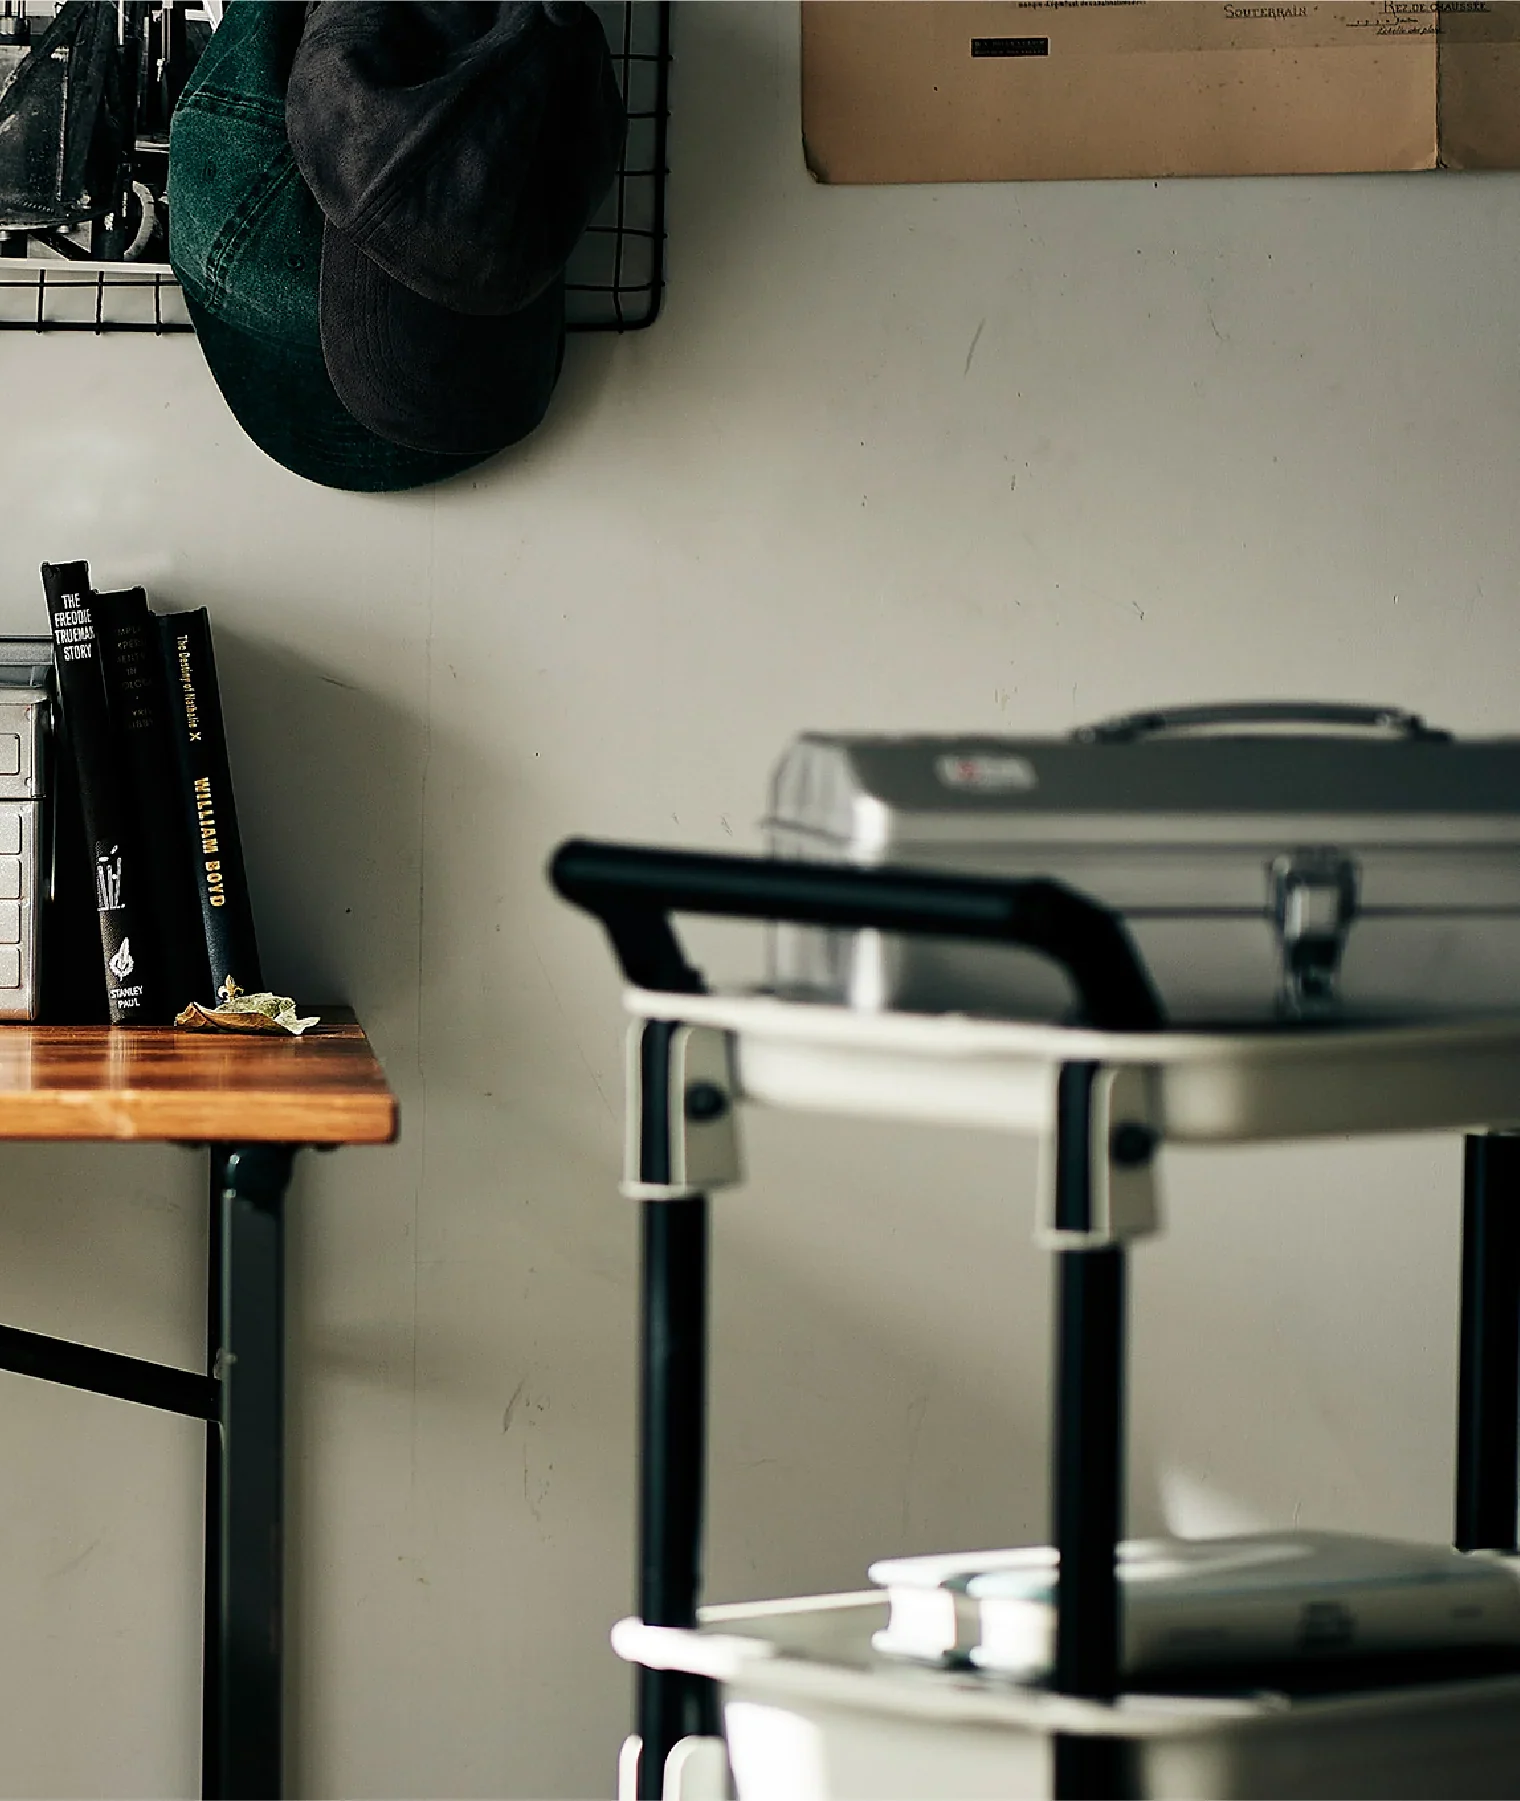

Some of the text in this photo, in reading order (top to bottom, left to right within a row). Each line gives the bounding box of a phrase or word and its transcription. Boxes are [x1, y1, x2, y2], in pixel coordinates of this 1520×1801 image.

[61, 593, 80, 609] THE
[54, 608, 92, 628] FREDDIE
[63, 643, 92, 661] STORY
[177, 635, 189, 651] The
[189, 731, 202, 742] X
[193, 776, 227, 907] WILLIAM BOYD
[109, 985, 143, 999] STANLEY
[117, 997, 141, 1009] PAUL
